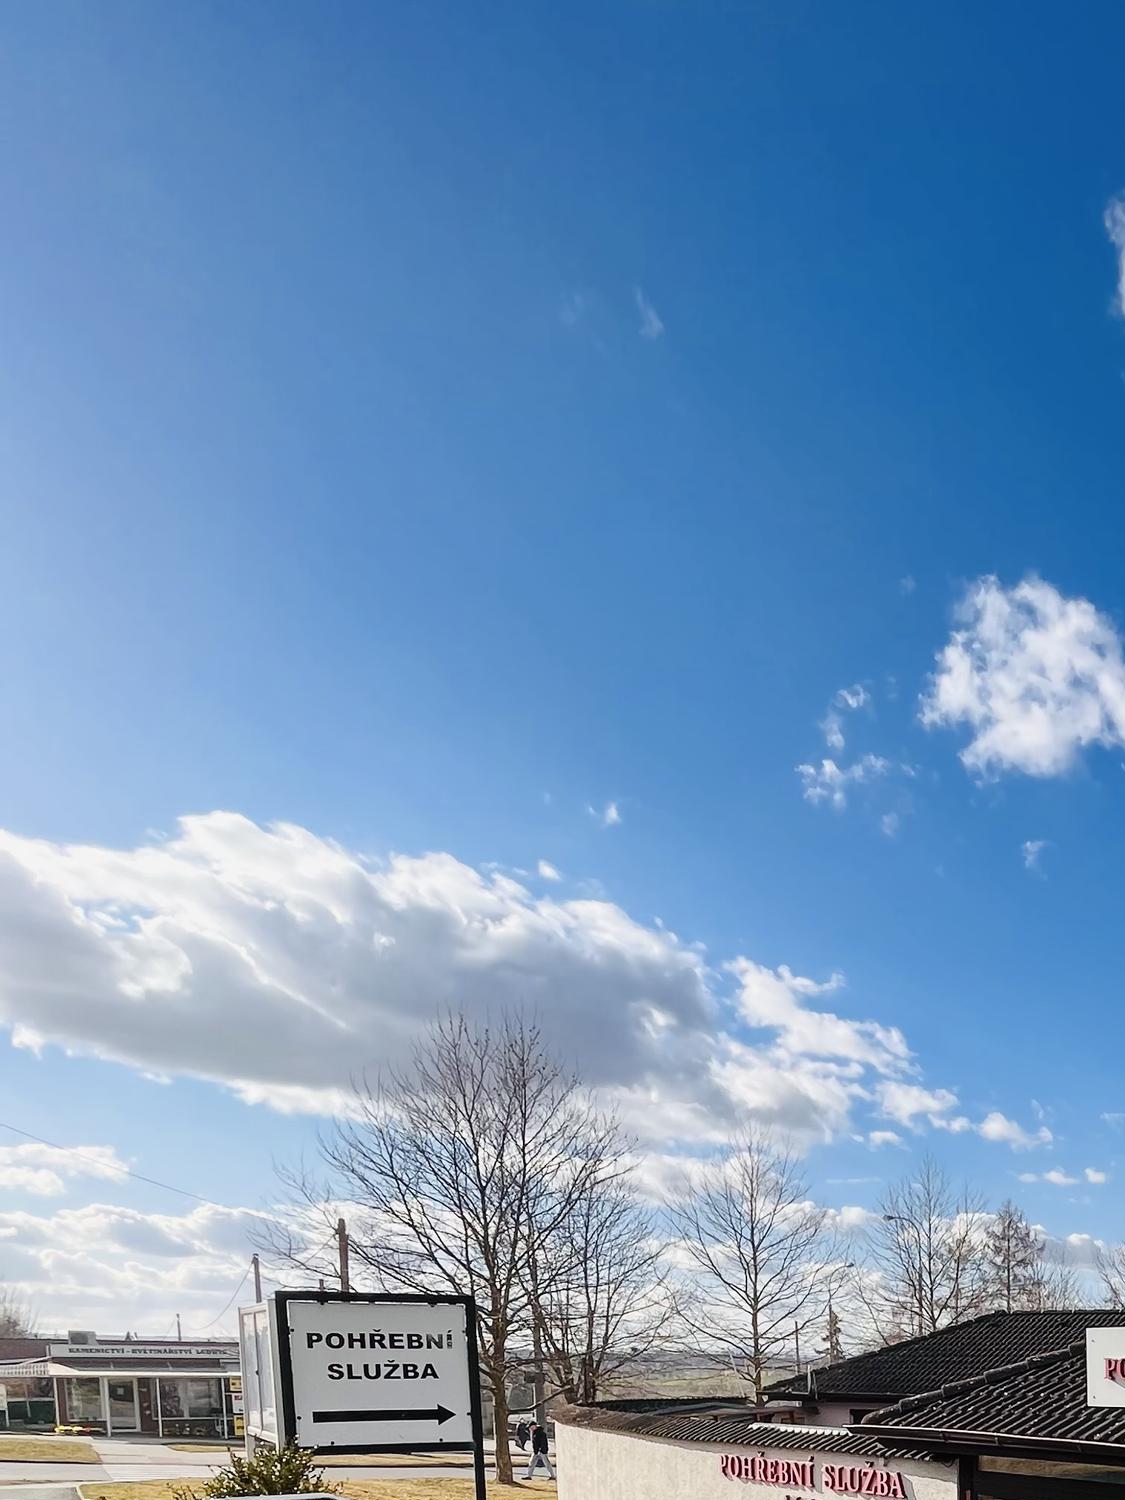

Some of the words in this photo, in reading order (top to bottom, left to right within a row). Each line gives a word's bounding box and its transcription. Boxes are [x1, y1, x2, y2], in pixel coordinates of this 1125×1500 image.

[306, 1329, 453, 1349] POHŘEBNÍ
[327, 1360, 439, 1380] SLUŽBA
[720, 1451, 815, 1488] POHŘEBNÍ
[821, 1461, 908, 1500] SLUŽBA
